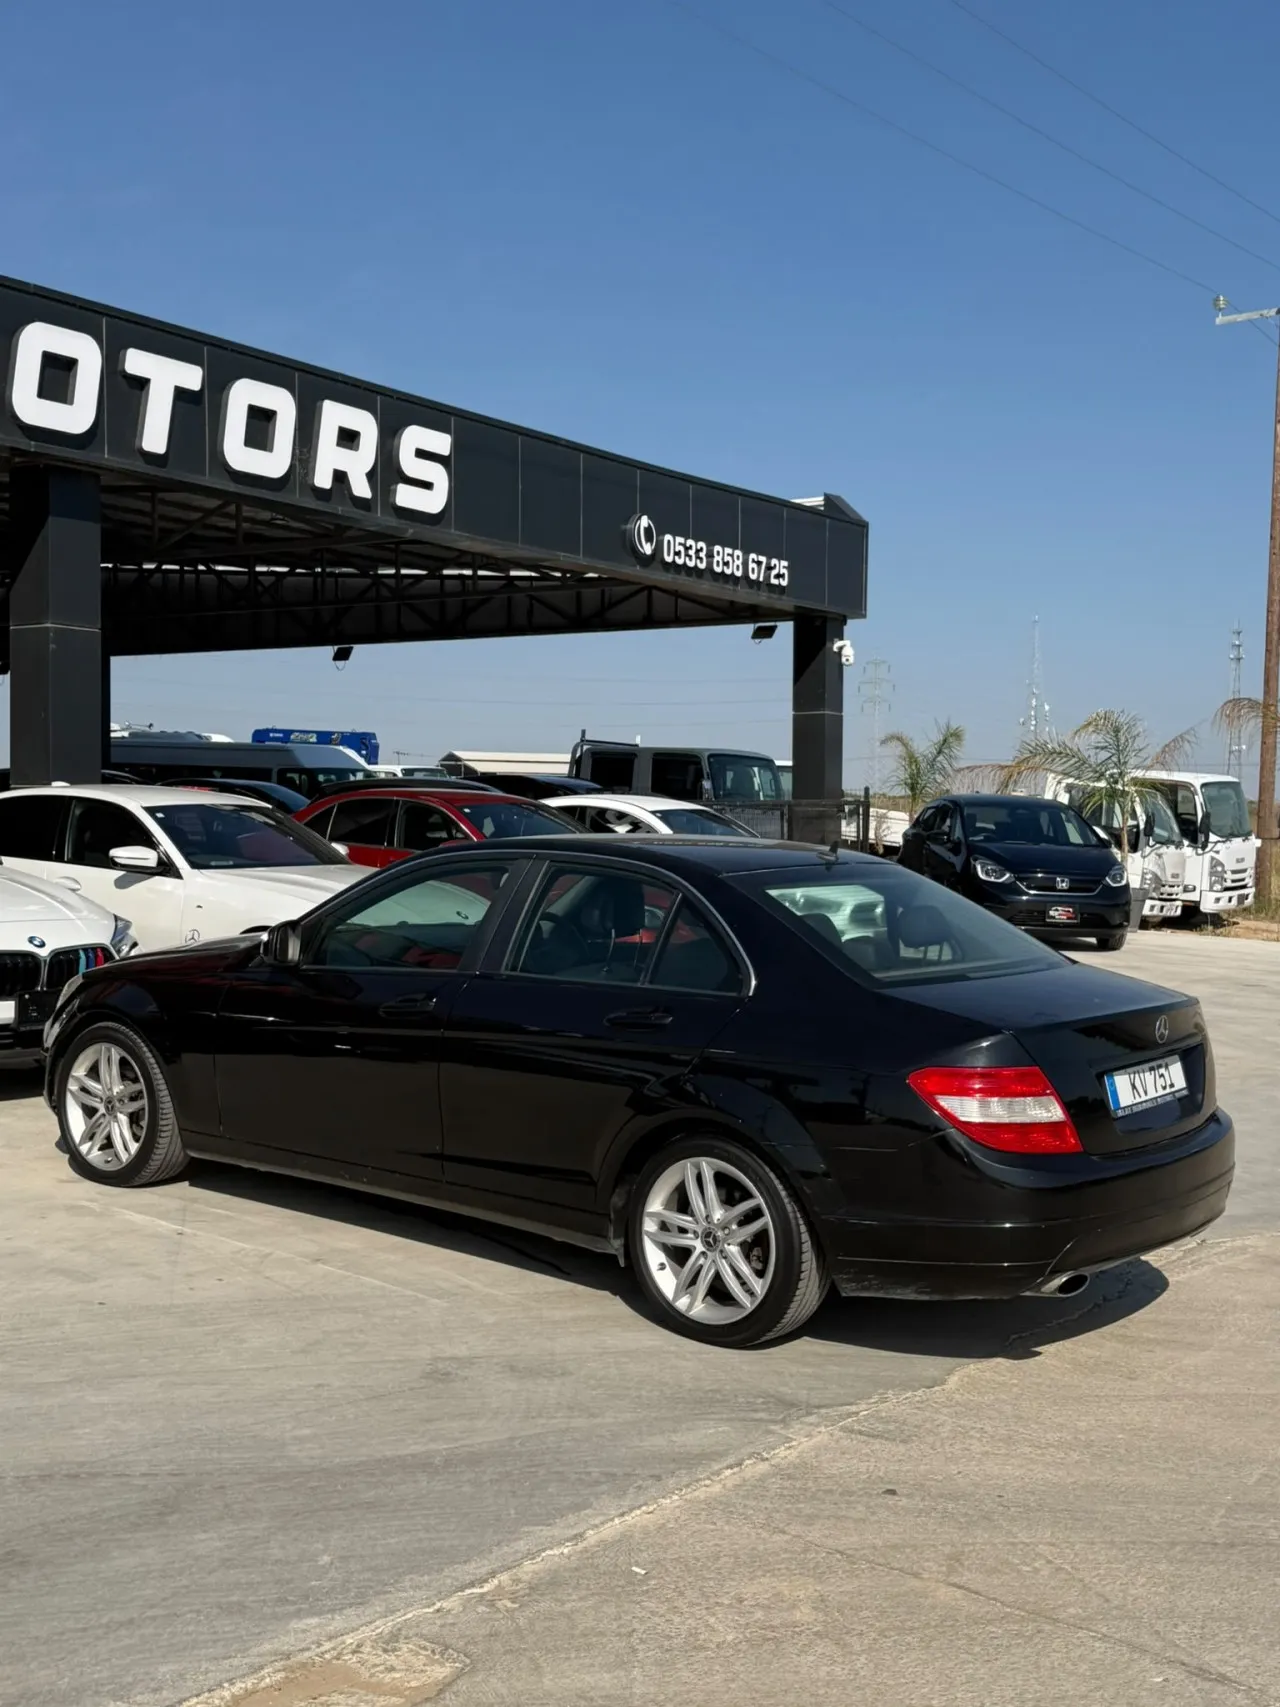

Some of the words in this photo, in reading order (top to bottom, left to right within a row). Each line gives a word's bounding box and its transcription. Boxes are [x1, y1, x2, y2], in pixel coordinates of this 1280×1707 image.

[12, 322, 452, 514] OTORS
[663, 533, 707, 570] 0533
[712, 545, 743, 577] 858
[748, 553, 766, 582] 67
[770, 558, 789, 587] 25
[1128, 1068, 1148, 1100] KV
[1149, 1062, 1175, 1093] 751
